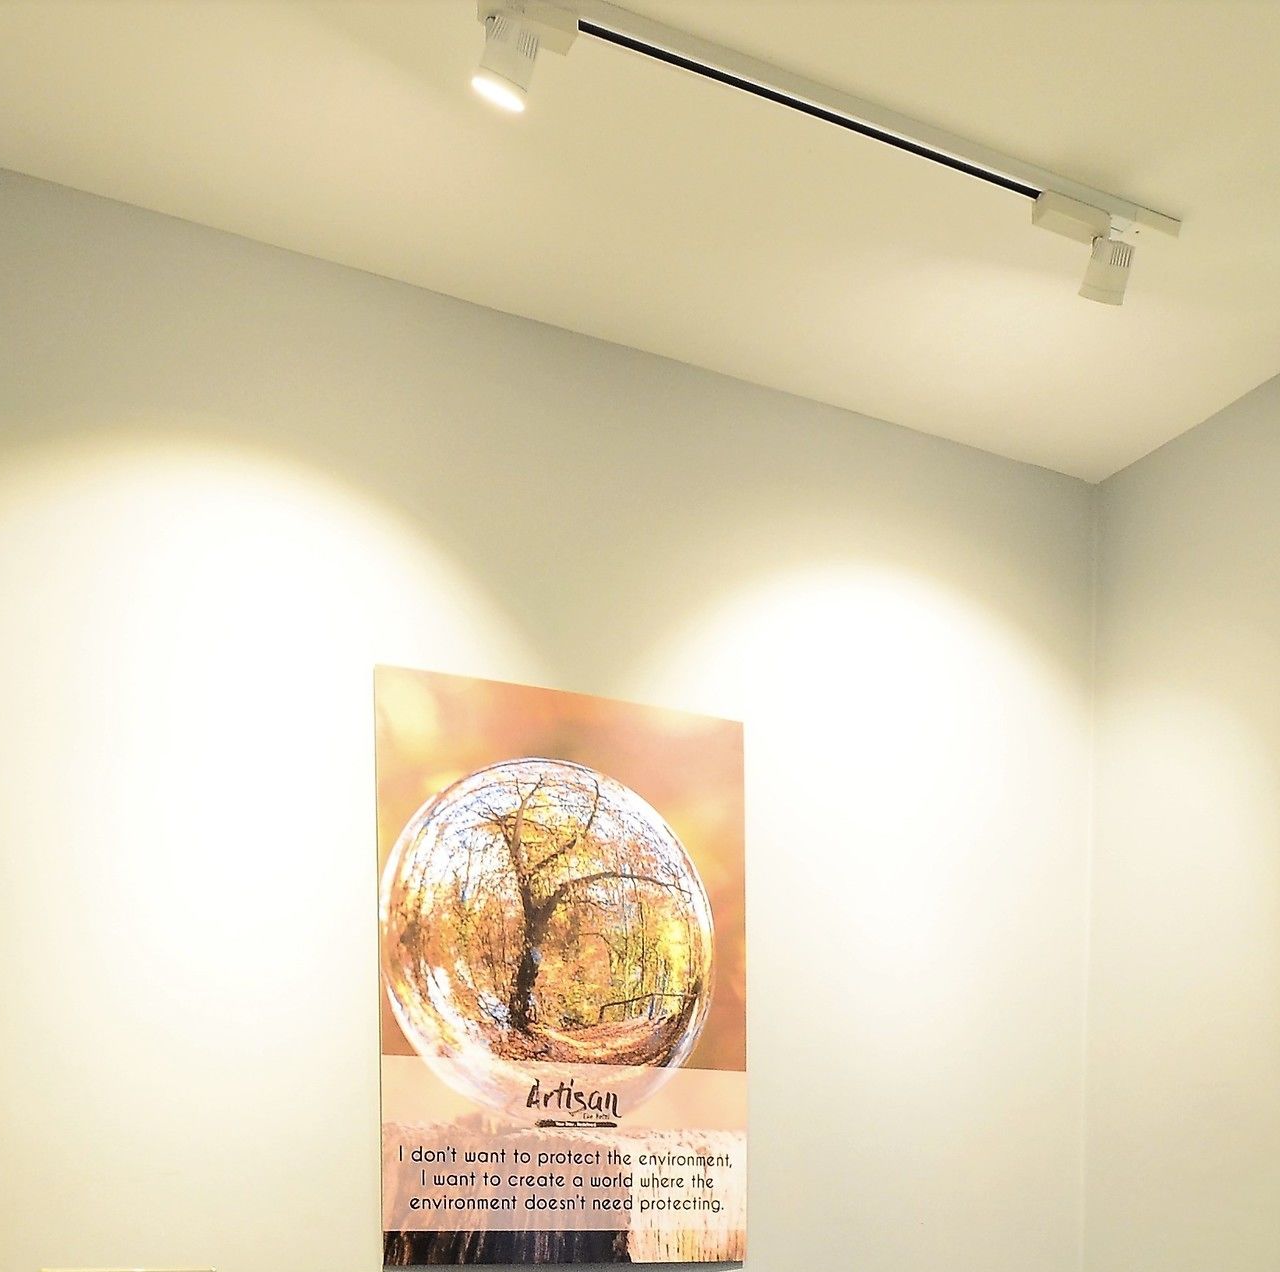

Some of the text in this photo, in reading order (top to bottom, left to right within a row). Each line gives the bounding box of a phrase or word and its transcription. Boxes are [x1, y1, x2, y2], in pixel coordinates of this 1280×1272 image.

[526, 1078, 622, 1118] Artisan
[411, 1145, 458, 1164] don't
[464, 1148, 506, 1164] want
[513, 1148, 532, 1165] to
[538, 1149, 600, 1168] protect
[607, 1150, 632, 1167] the
[638, 1151, 733, 1170] environment,
[433, 1172, 476, 1188] want
[483, 1172, 500, 1188] to
[507, 1173, 565, 1189] create
[572, 1176, 584, 1189] a
[590, 1171, 633, 1189] world
[640, 1172, 685, 1190] where
[691, 1173, 714, 1190] the
[409, 1193, 725, 1214] environment doesn't need protecting.
